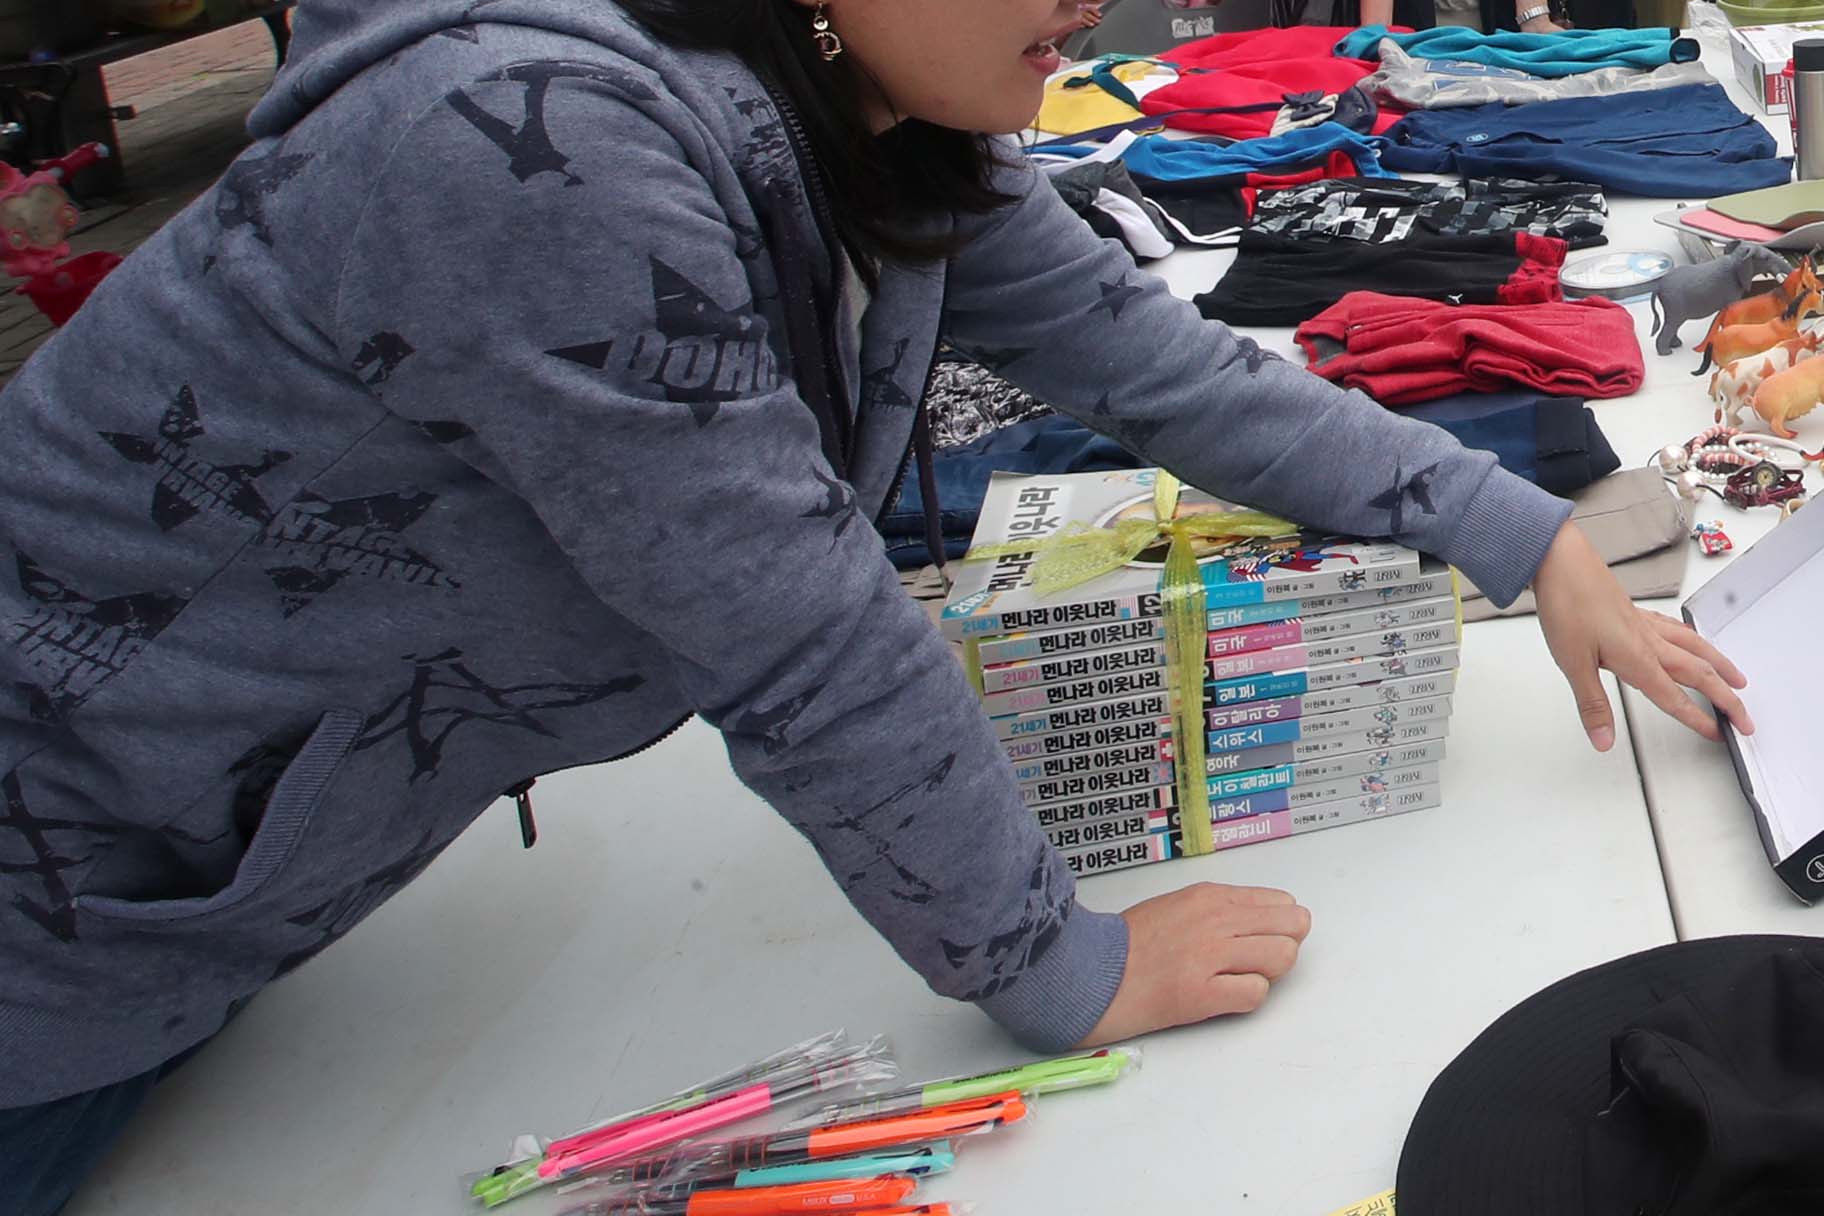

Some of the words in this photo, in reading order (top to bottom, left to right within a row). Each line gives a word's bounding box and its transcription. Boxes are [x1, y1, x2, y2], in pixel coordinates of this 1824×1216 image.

[962, 617, 998, 633] 21세기
[1001, 609, 1049, 630] 먼나라
[1053, 600, 1117, 623] 이웃나라
[1039, 632, 1087, 653] 먼나라
[1091, 621, 1154, 645] 이웃나라
[1041, 658, 1089, 680] 먼나라
[1093, 647, 1156, 671] 이웃나라
[1213, 635, 1247, 653] 미국
[1047, 682, 1094, 704] 먼나라
[1098, 670, 1161, 694] 이웃나라
[1011, 719, 1047, 735] 21세기
[1049, 707, 1096, 730] 먼나라
[1100, 696, 1163, 720] 이웃나라
[1219, 684, 1256, 701] 일본
[1007, 743, 1042, 757] 21세기
[1044, 731, 1091, 754] 먼나라
[1095, 721, 1157, 744] 이웃나라
[1213, 704, 1281, 725] 이탈리아
[1044, 755, 1091, 777] 먼나라
[1095, 745, 1157, 768] 이웃나라
[1213, 729, 1263, 749] 스위스
[1038, 779, 1085, 800] 먼나라
[1088, 767, 1151, 791] 이웃나라
[1206, 755, 1240, 772] 영국
[1038, 805, 1084, 827] 먼나라
[1088, 793, 1151, 816] 이웃나라
[1083, 817, 1146, 841] 이웃나라
[1086, 843, 1149, 868] 이웃나라
